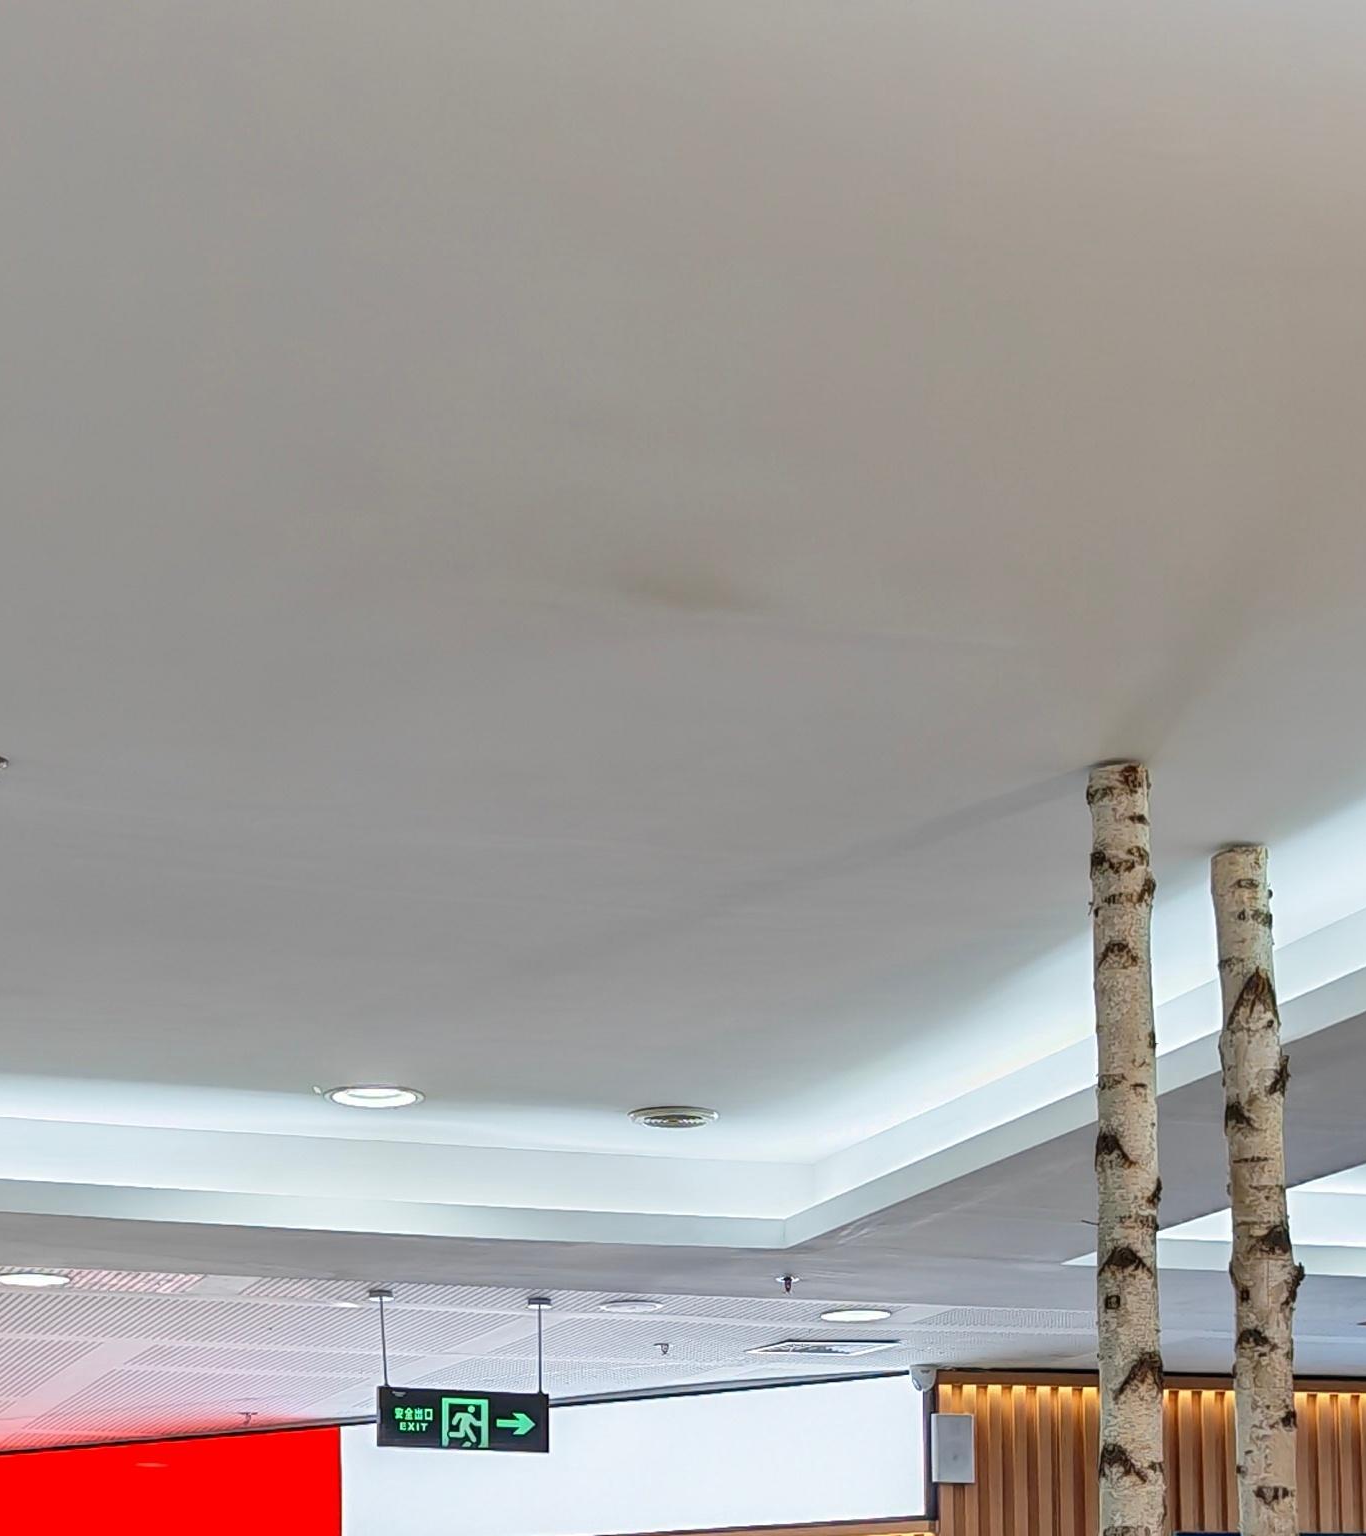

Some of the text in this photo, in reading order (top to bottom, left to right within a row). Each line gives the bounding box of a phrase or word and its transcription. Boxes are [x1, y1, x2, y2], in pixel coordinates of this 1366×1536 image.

[394, 1407, 433, 1421] 安全出口
[399, 1422, 429, 1432] EXIT
